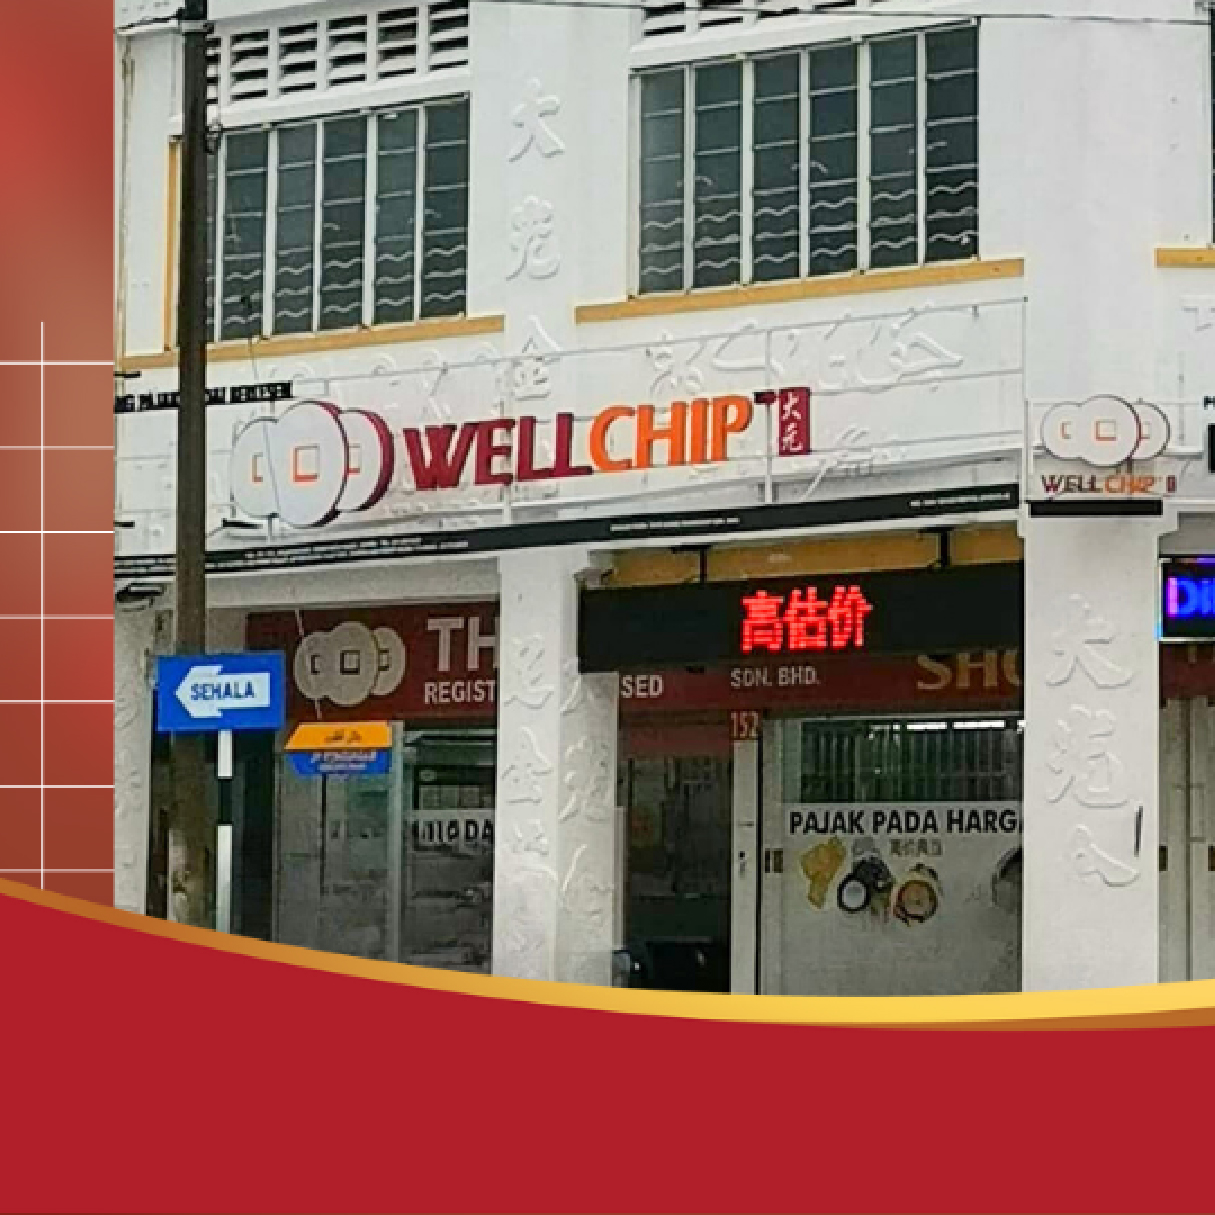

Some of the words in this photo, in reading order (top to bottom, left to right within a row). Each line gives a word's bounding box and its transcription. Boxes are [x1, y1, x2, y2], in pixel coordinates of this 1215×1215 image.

[402, 394, 754, 491] WELLCHIP
[741, 586, 874, 655] 高估价
[619, 673, 665, 699] SED
[730, 666, 772, 688] SDN.
[777, 665, 821, 686] BHD.
[190, 682, 255, 701] SEHALA
[730, 711, 760, 740] 152
[789, 809, 866, 835] PAJAK
[872, 809, 939, 835] PADA
[946, 808, 1023, 835] HARG
